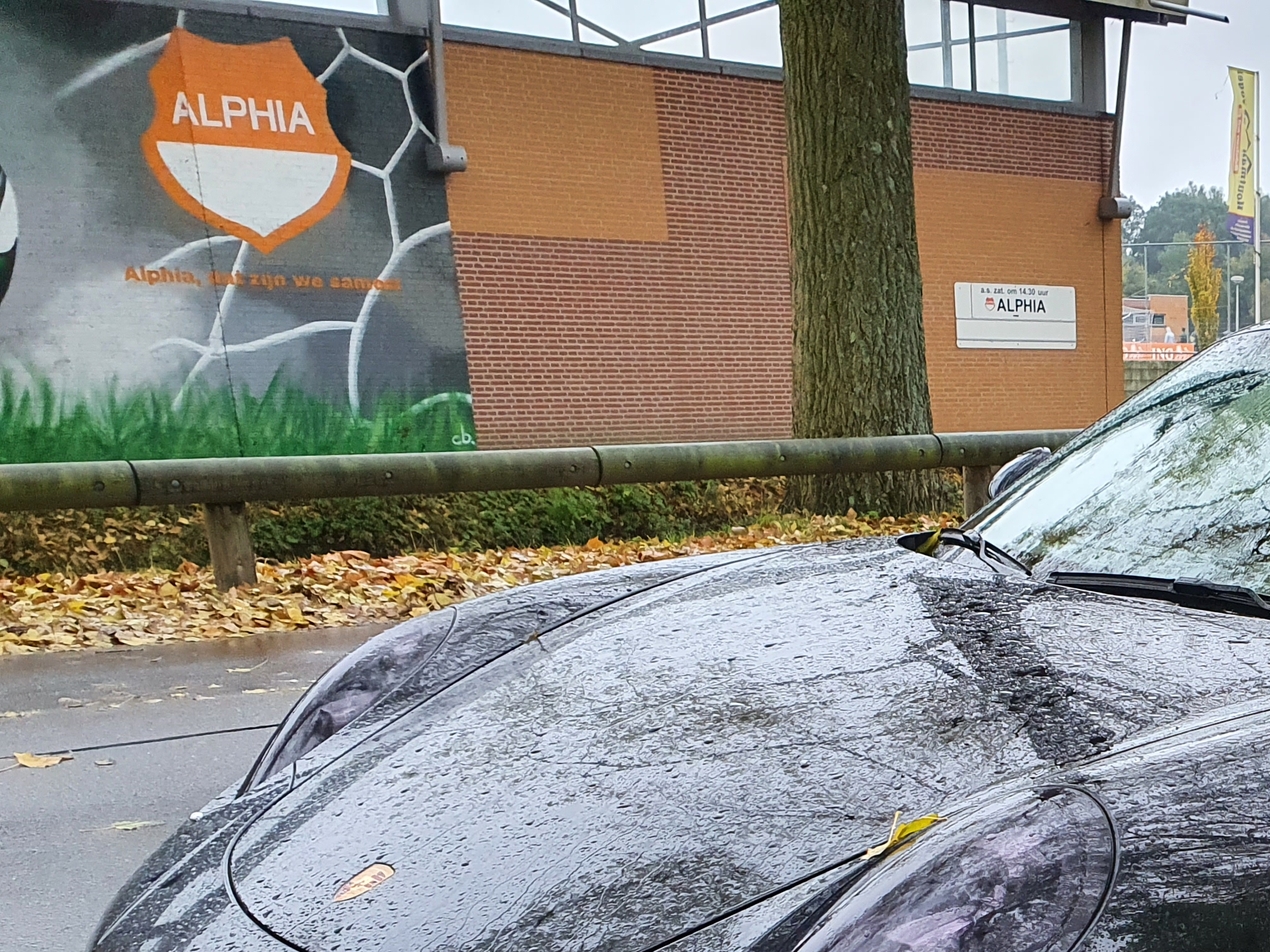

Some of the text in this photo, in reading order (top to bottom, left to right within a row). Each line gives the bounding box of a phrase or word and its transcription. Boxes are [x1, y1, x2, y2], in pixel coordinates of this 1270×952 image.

[172, 92, 315, 136] ALPHIA
[124, 266, 202, 288] Alphia,
[250, 274, 287, 291] zijn
[293, 274, 324, 289] we
[997, 298, 1046, 313] ALPHIA
[1151, 348, 1174, 361] ING
